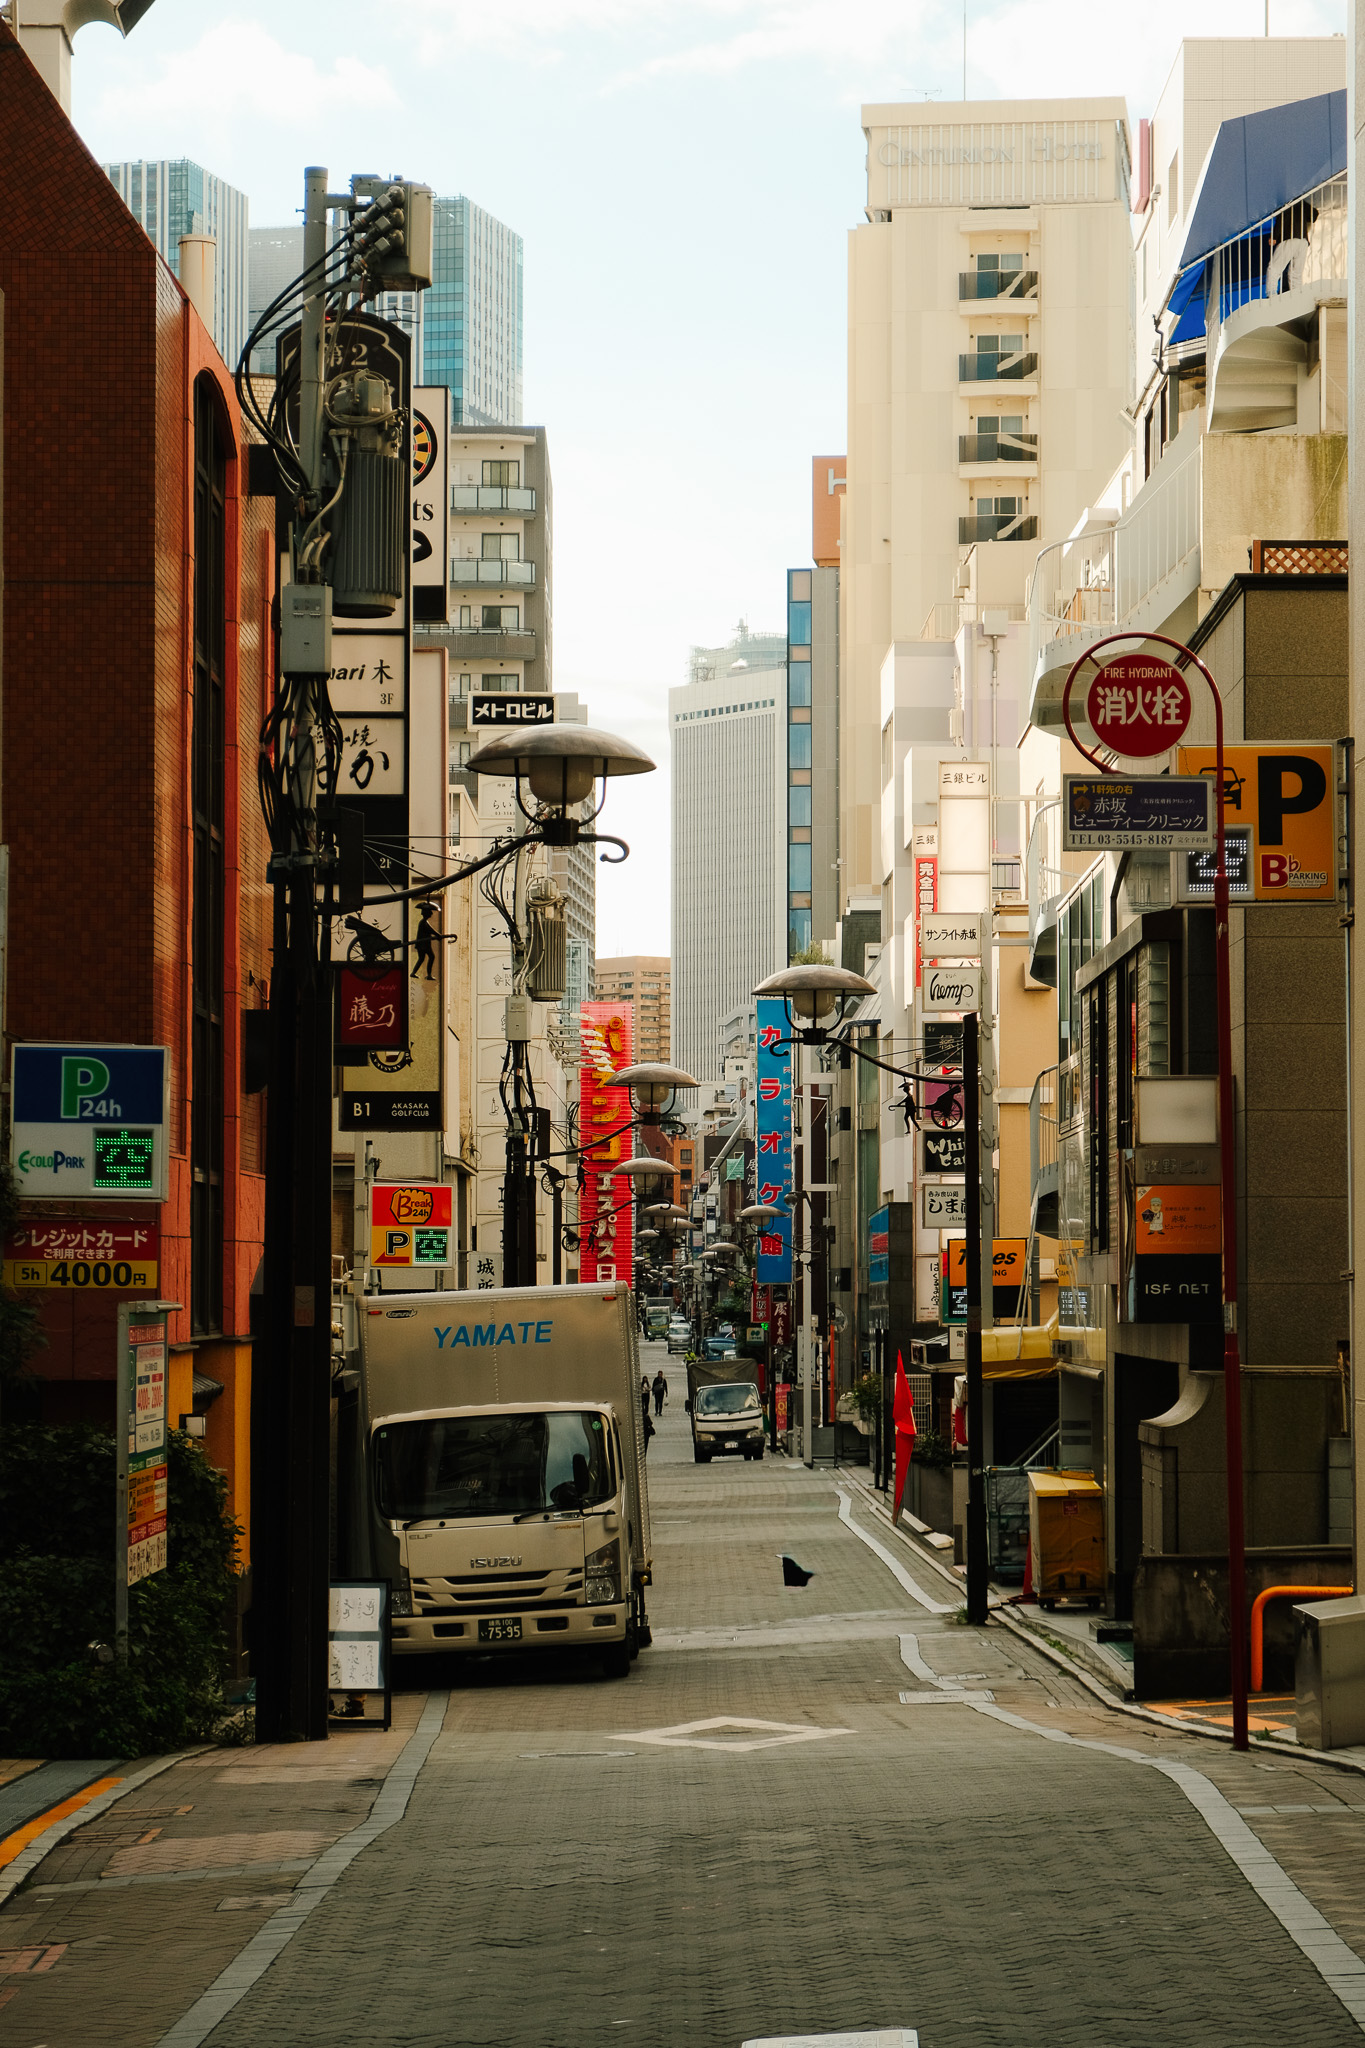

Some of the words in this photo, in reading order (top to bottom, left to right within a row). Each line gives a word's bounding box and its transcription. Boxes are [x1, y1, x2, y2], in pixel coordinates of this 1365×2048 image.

[1104, 667, 1125, 679] FIRE
[1128, 667, 1173, 679] HYDRANT
[380, 693, 394, 704] 3F
[1097, 685, 1184, 725] 消火栓
[475, 703, 553, 719] メトロビル
[942, 772, 988, 784] 三銀ビル
[1091, 784, 1133, 795] 1軒先の右
[1094, 797, 1127, 814] 赤坂
[1257, 755, 1327, 846] P
[1073, 814, 1204, 829] ビューティークリニック
[1069, 834, 1095, 845] TEL
[1097, 834, 1174, 845] 03-5545-8187
[379, 858, 392, 869] 2F
[1289, 872, 1326, 880] PARKING
[926, 929, 977, 941] サンライト赤坂
[349, 995, 396, 1031] 藤乃
[60, 1056, 110, 1119] P
[82, 1099, 122, 1118] 24h
[353, 1102, 371, 1117] B1
[759, 1025, 783, 1256] カラオケ館
[926, 1137, 966, 1154] Whi
[95, 1131, 152, 1188] 空
[397, 1193, 431, 1219] Break
[412, 1209, 429, 1217] 24h
[596, 1171, 619, 1282] エスパス日
[13, 1229, 148, 1248] クレジットカード
[386, 1231, 410, 1256] P
[415, 1230, 448, 1262] 空
[43, 1248, 116, 1260] ご利用できます
[958, 1248, 1018, 1266] Tes
[21, 1267, 40, 1281] 5h
[50, 1262, 146, 1287] 4000円
[1145, 1283, 1172, 1295] ISF
[433, 1320, 553, 1349] YAMATE
[470, 1556, 522, 1569] ISUZU
[488, 1625, 521, 1640] 75-95
